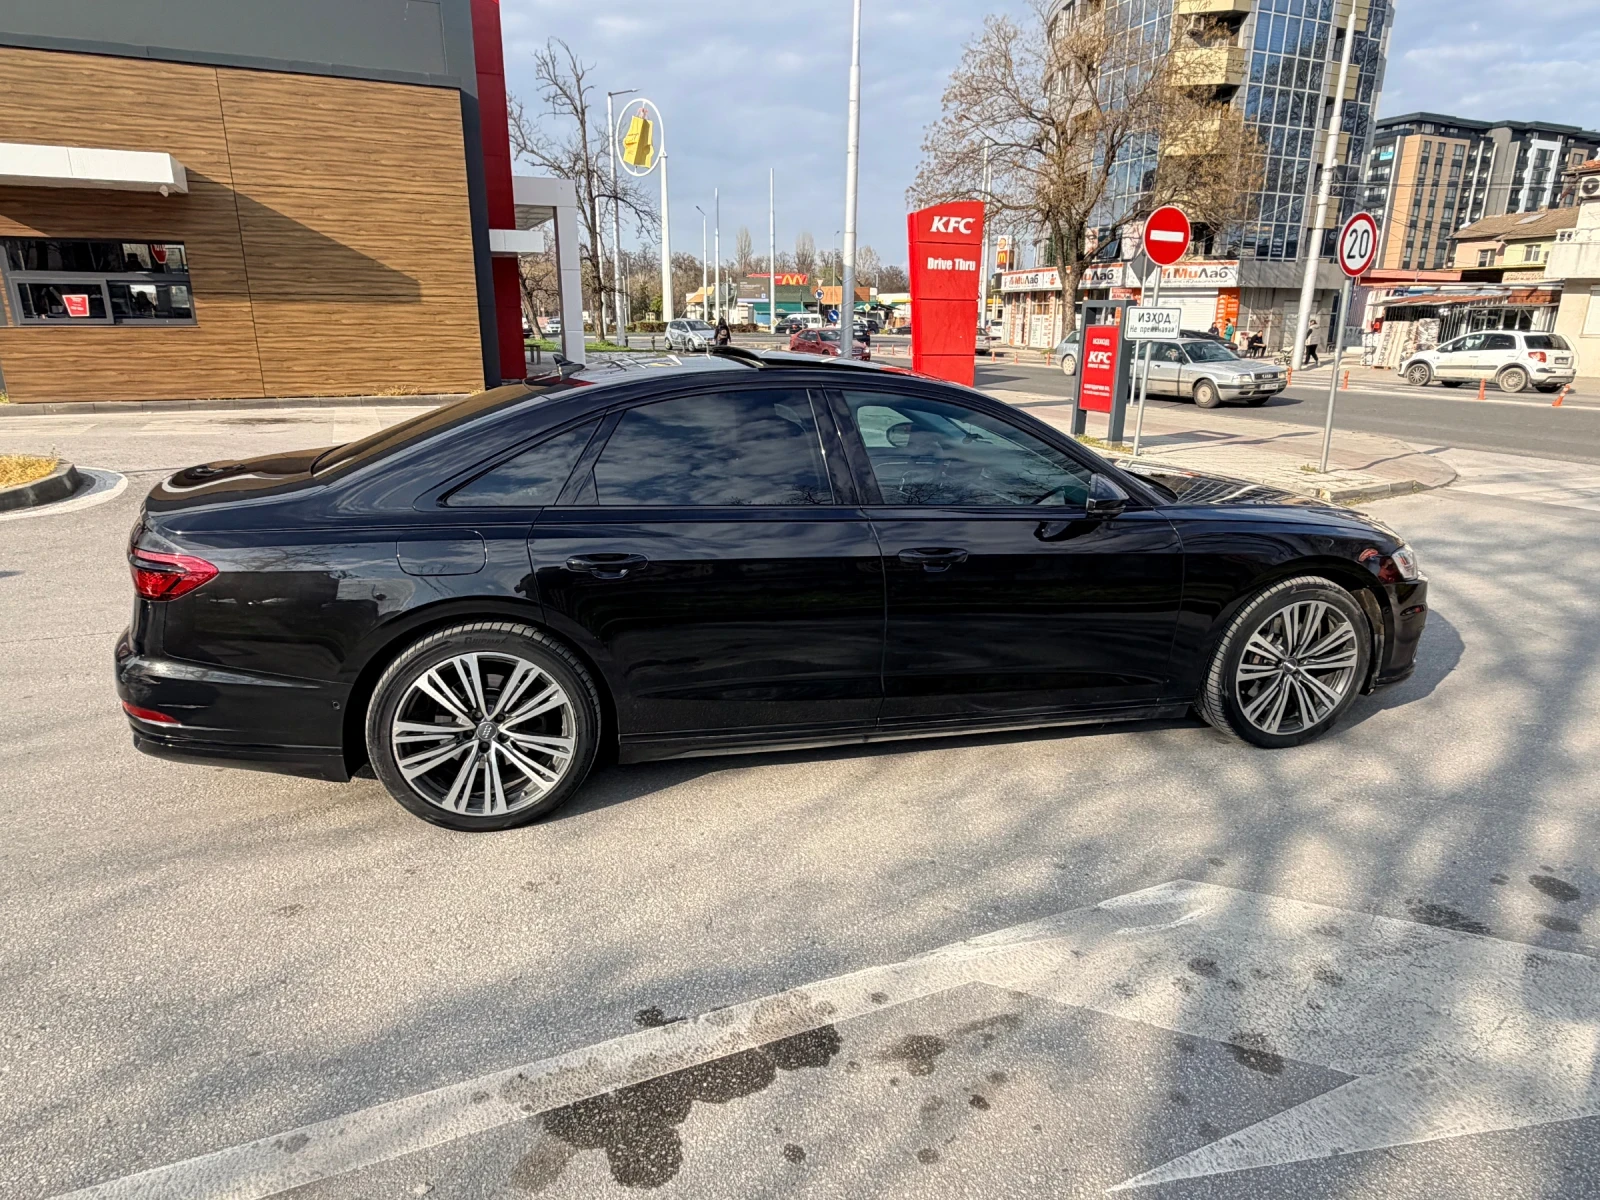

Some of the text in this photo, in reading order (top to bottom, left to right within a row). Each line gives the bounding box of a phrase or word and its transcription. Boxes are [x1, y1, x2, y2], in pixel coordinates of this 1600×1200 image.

[930, 216, 976, 234] KFC
[1347, 228, 1370, 259] 20
[927, 257, 976, 271] Drive Thru
[1138, 312, 1171, 325] ИЗХОД
[1088, 351, 1112, 364] KFC
